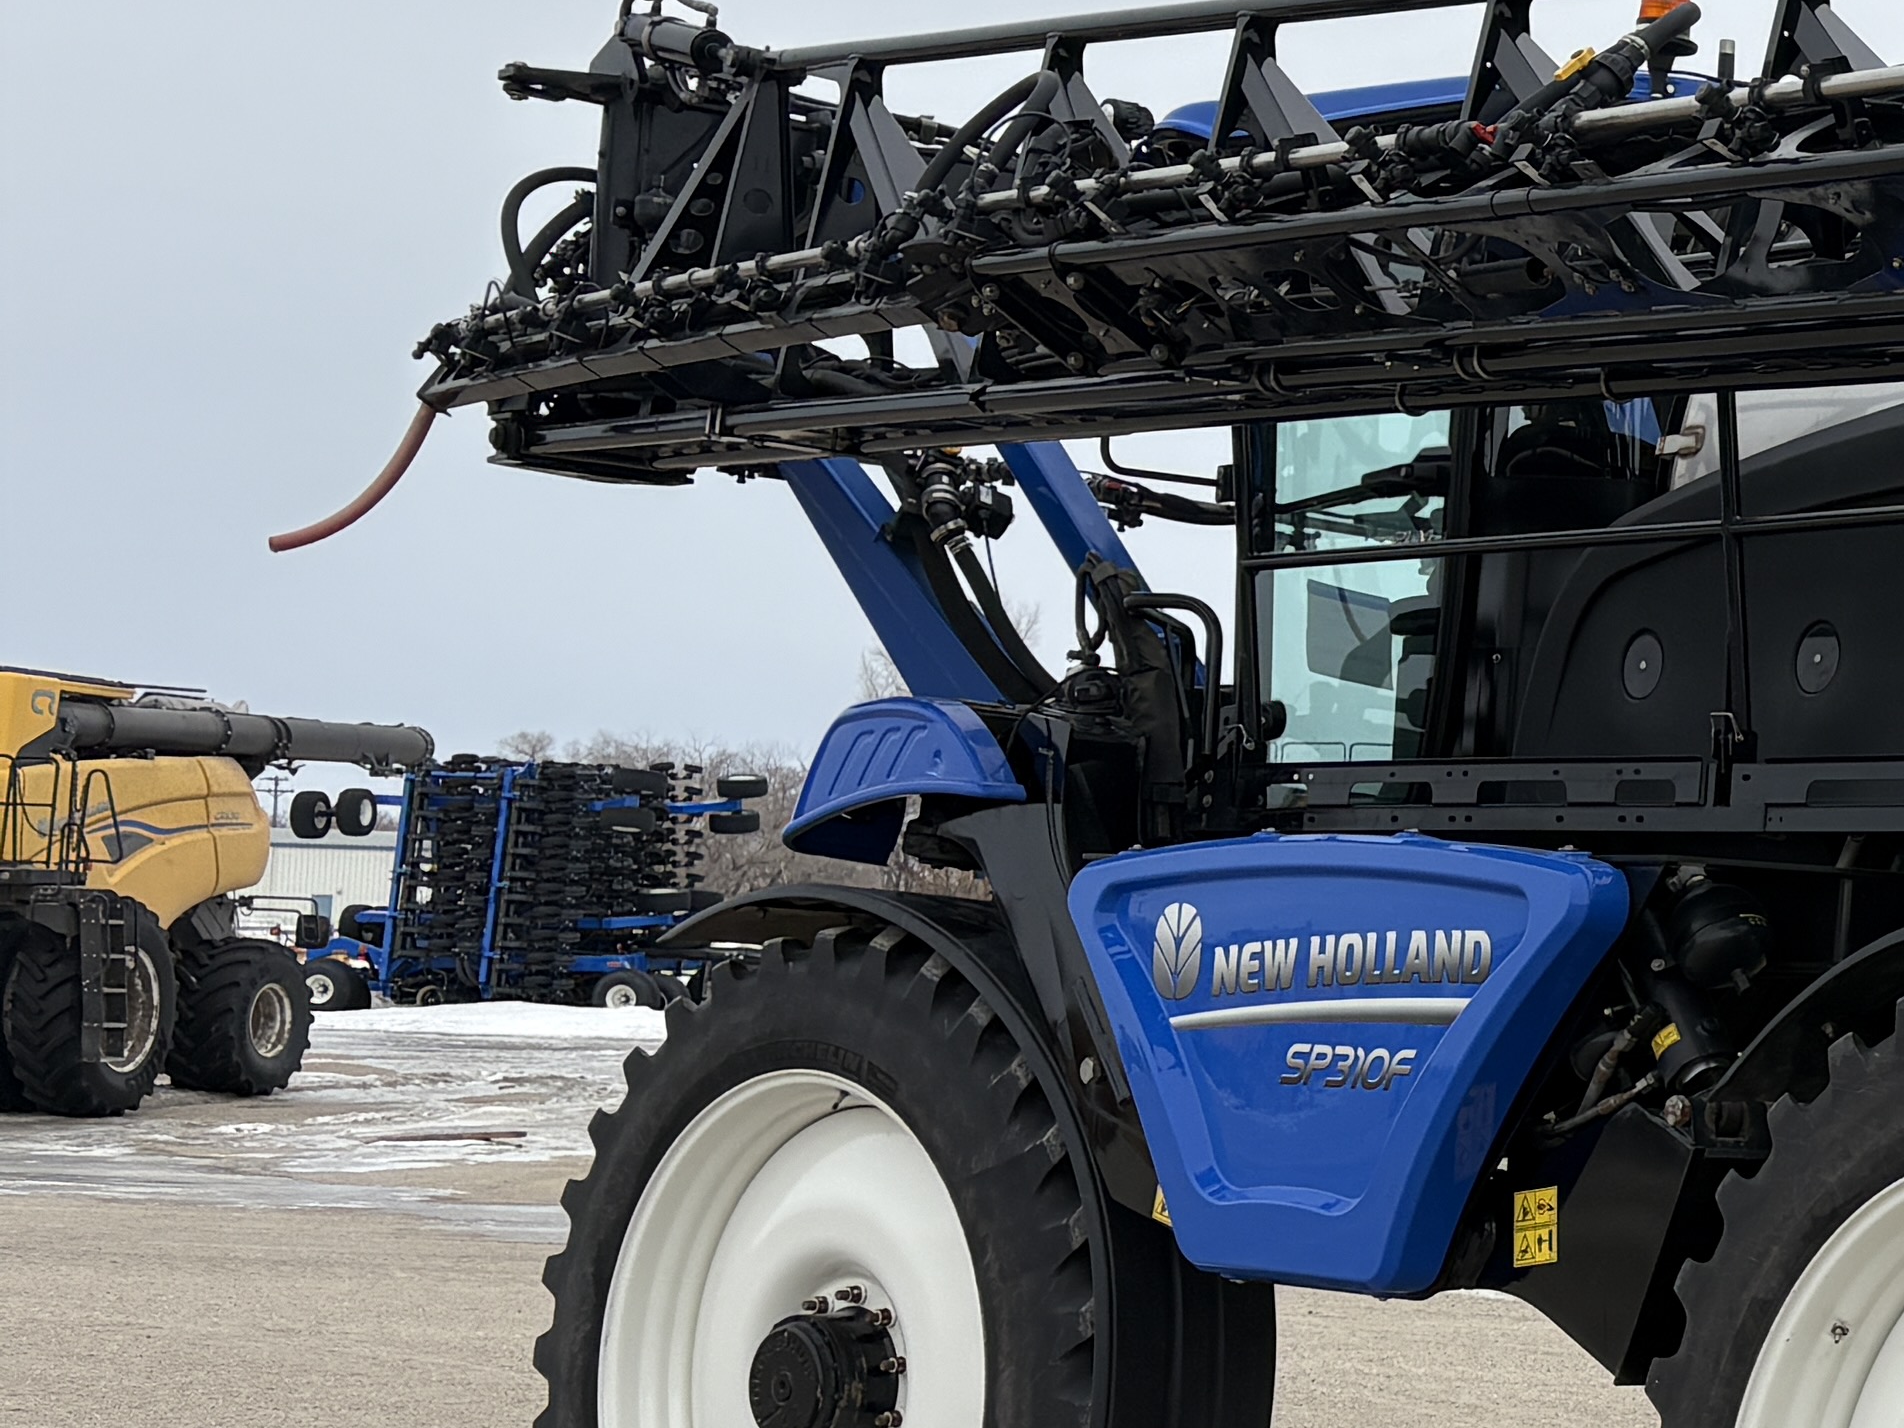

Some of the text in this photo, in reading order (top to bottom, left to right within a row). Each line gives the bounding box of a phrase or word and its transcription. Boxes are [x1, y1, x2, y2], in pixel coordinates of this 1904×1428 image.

[1211, 929, 1492, 996] NEW HOLLAND
[1280, 1043, 1417, 1090] SP310F
